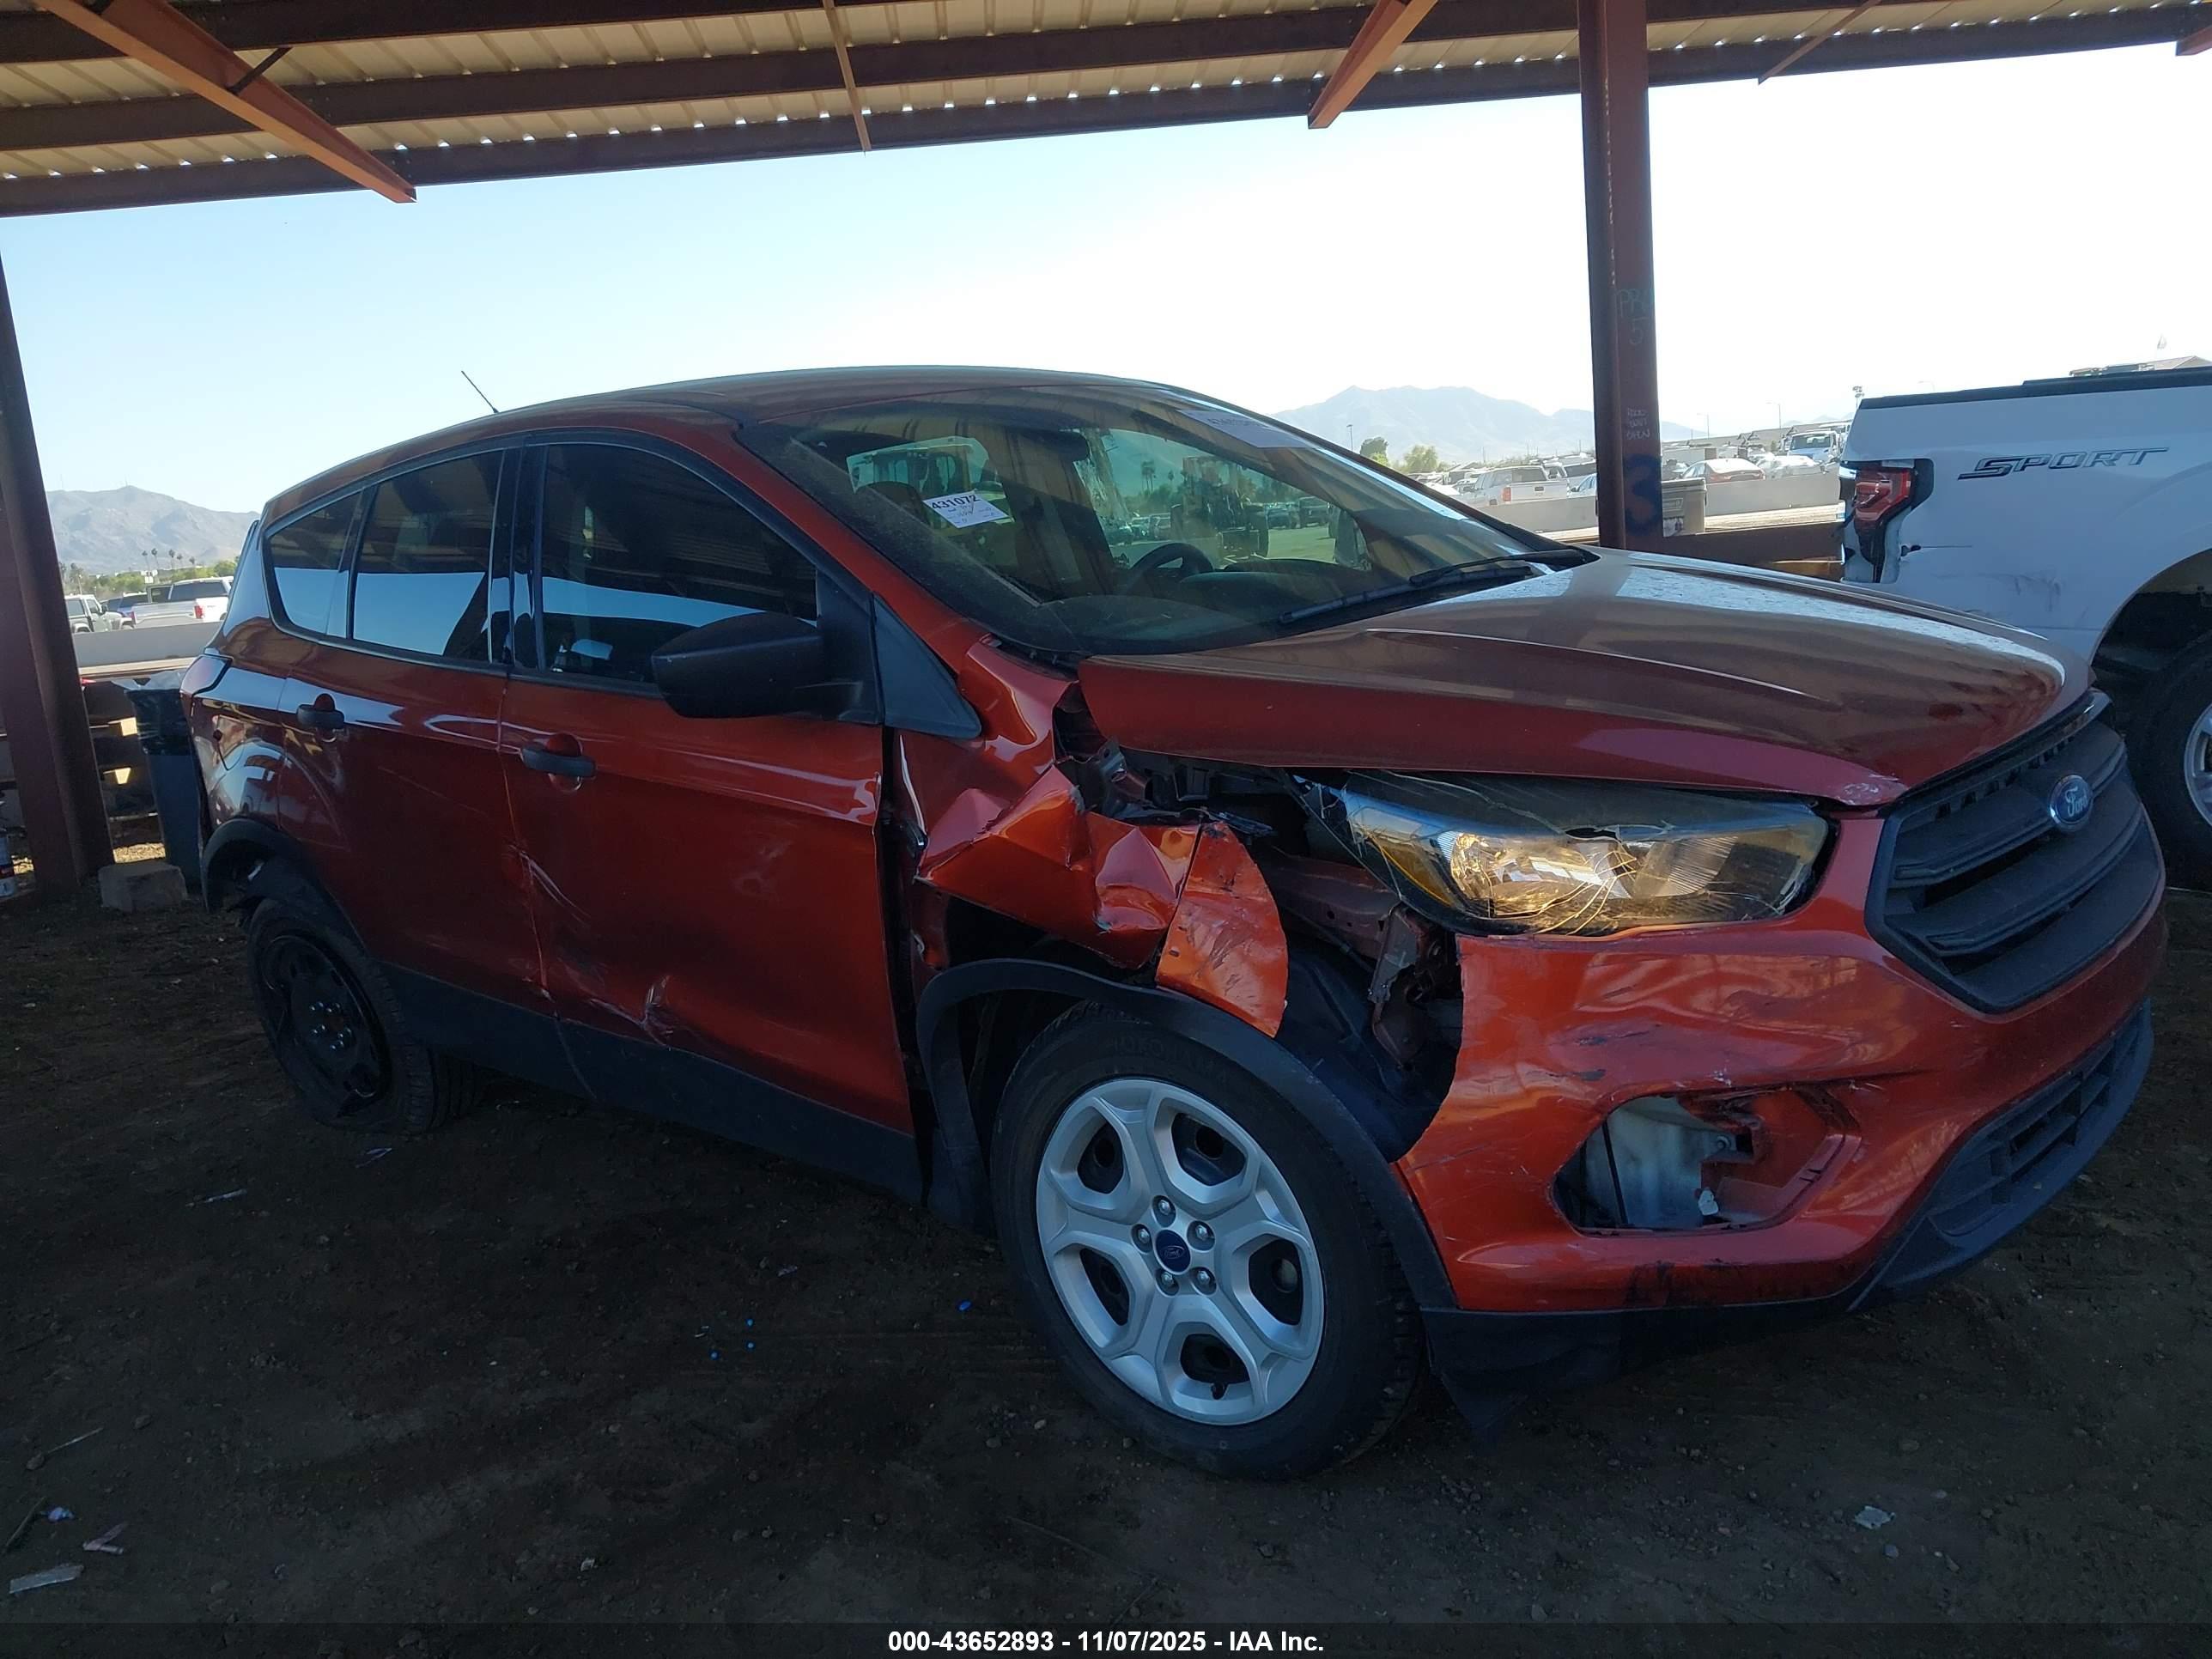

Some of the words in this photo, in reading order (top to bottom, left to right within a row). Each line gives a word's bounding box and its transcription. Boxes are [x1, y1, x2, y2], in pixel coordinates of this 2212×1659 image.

[1957, 447, 2170, 480] SPORT
[932, 495, 981, 509] 431072
[2065, 786, 2088, 817] Ford
